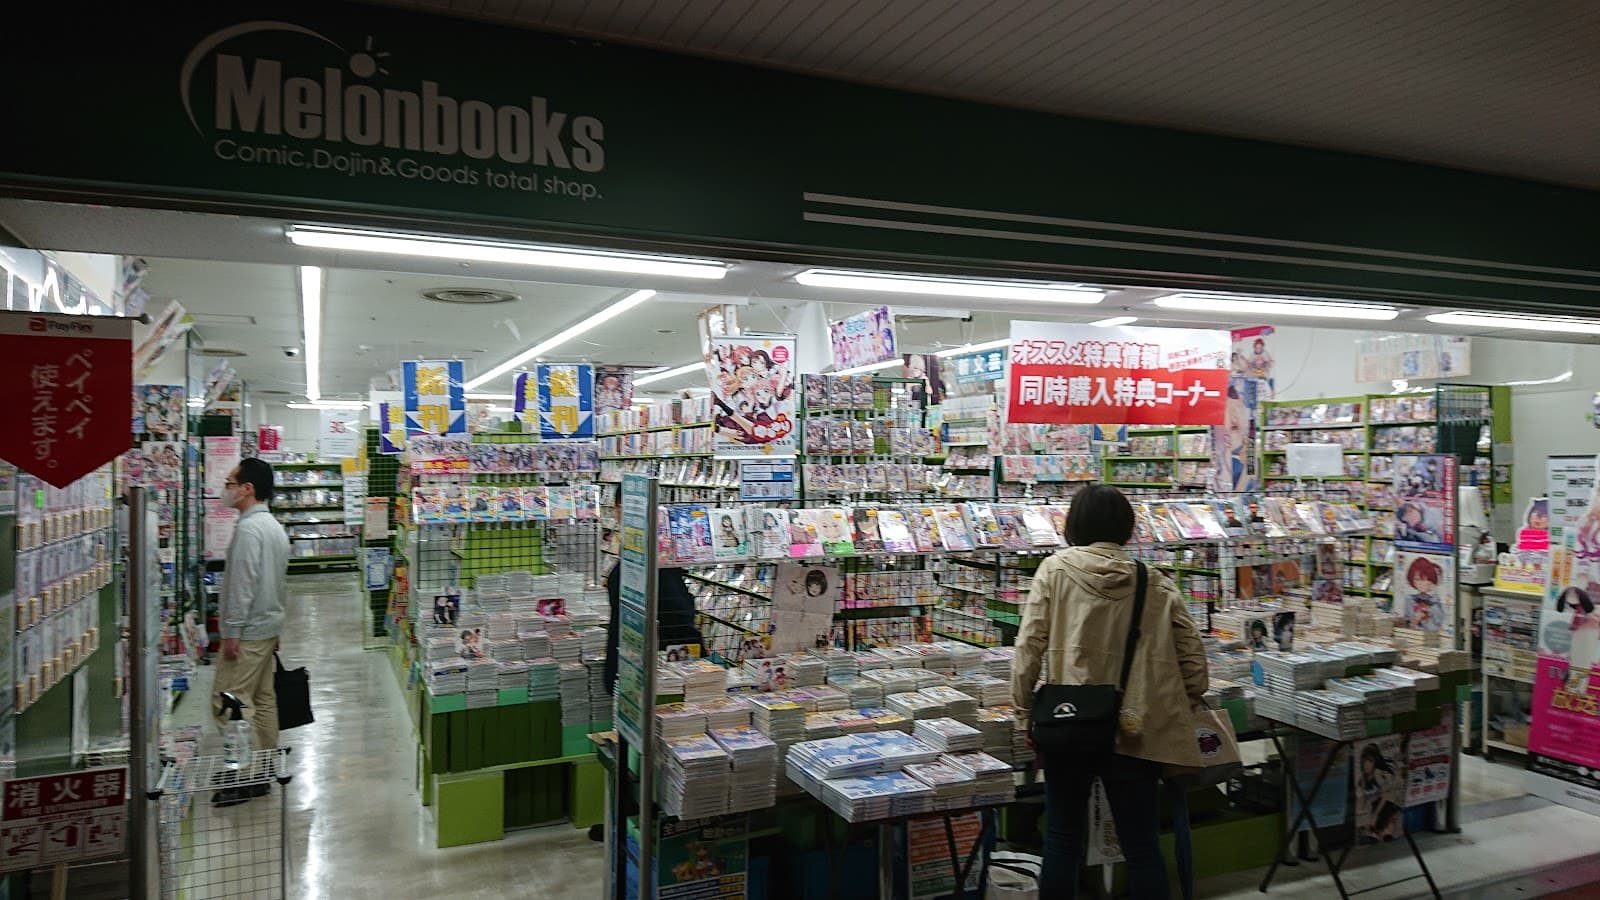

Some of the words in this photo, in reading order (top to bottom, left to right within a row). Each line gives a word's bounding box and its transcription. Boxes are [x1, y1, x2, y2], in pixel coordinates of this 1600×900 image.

[215, 53, 605, 173] Melonbooks
[214, 138, 479, 186] Comic,Dojin&Goods
[485, 167, 538, 191] total
[543, 175, 603, 201] shop.
[1011, 339, 1161, 370] オススメ特典情報
[31, 363, 60, 469] 使えます。
[65, 349, 93, 440] ペイペイ
[1018, 374, 1221, 407] 同時購入特典コーナー
[8, 772, 120, 808] 消火器
